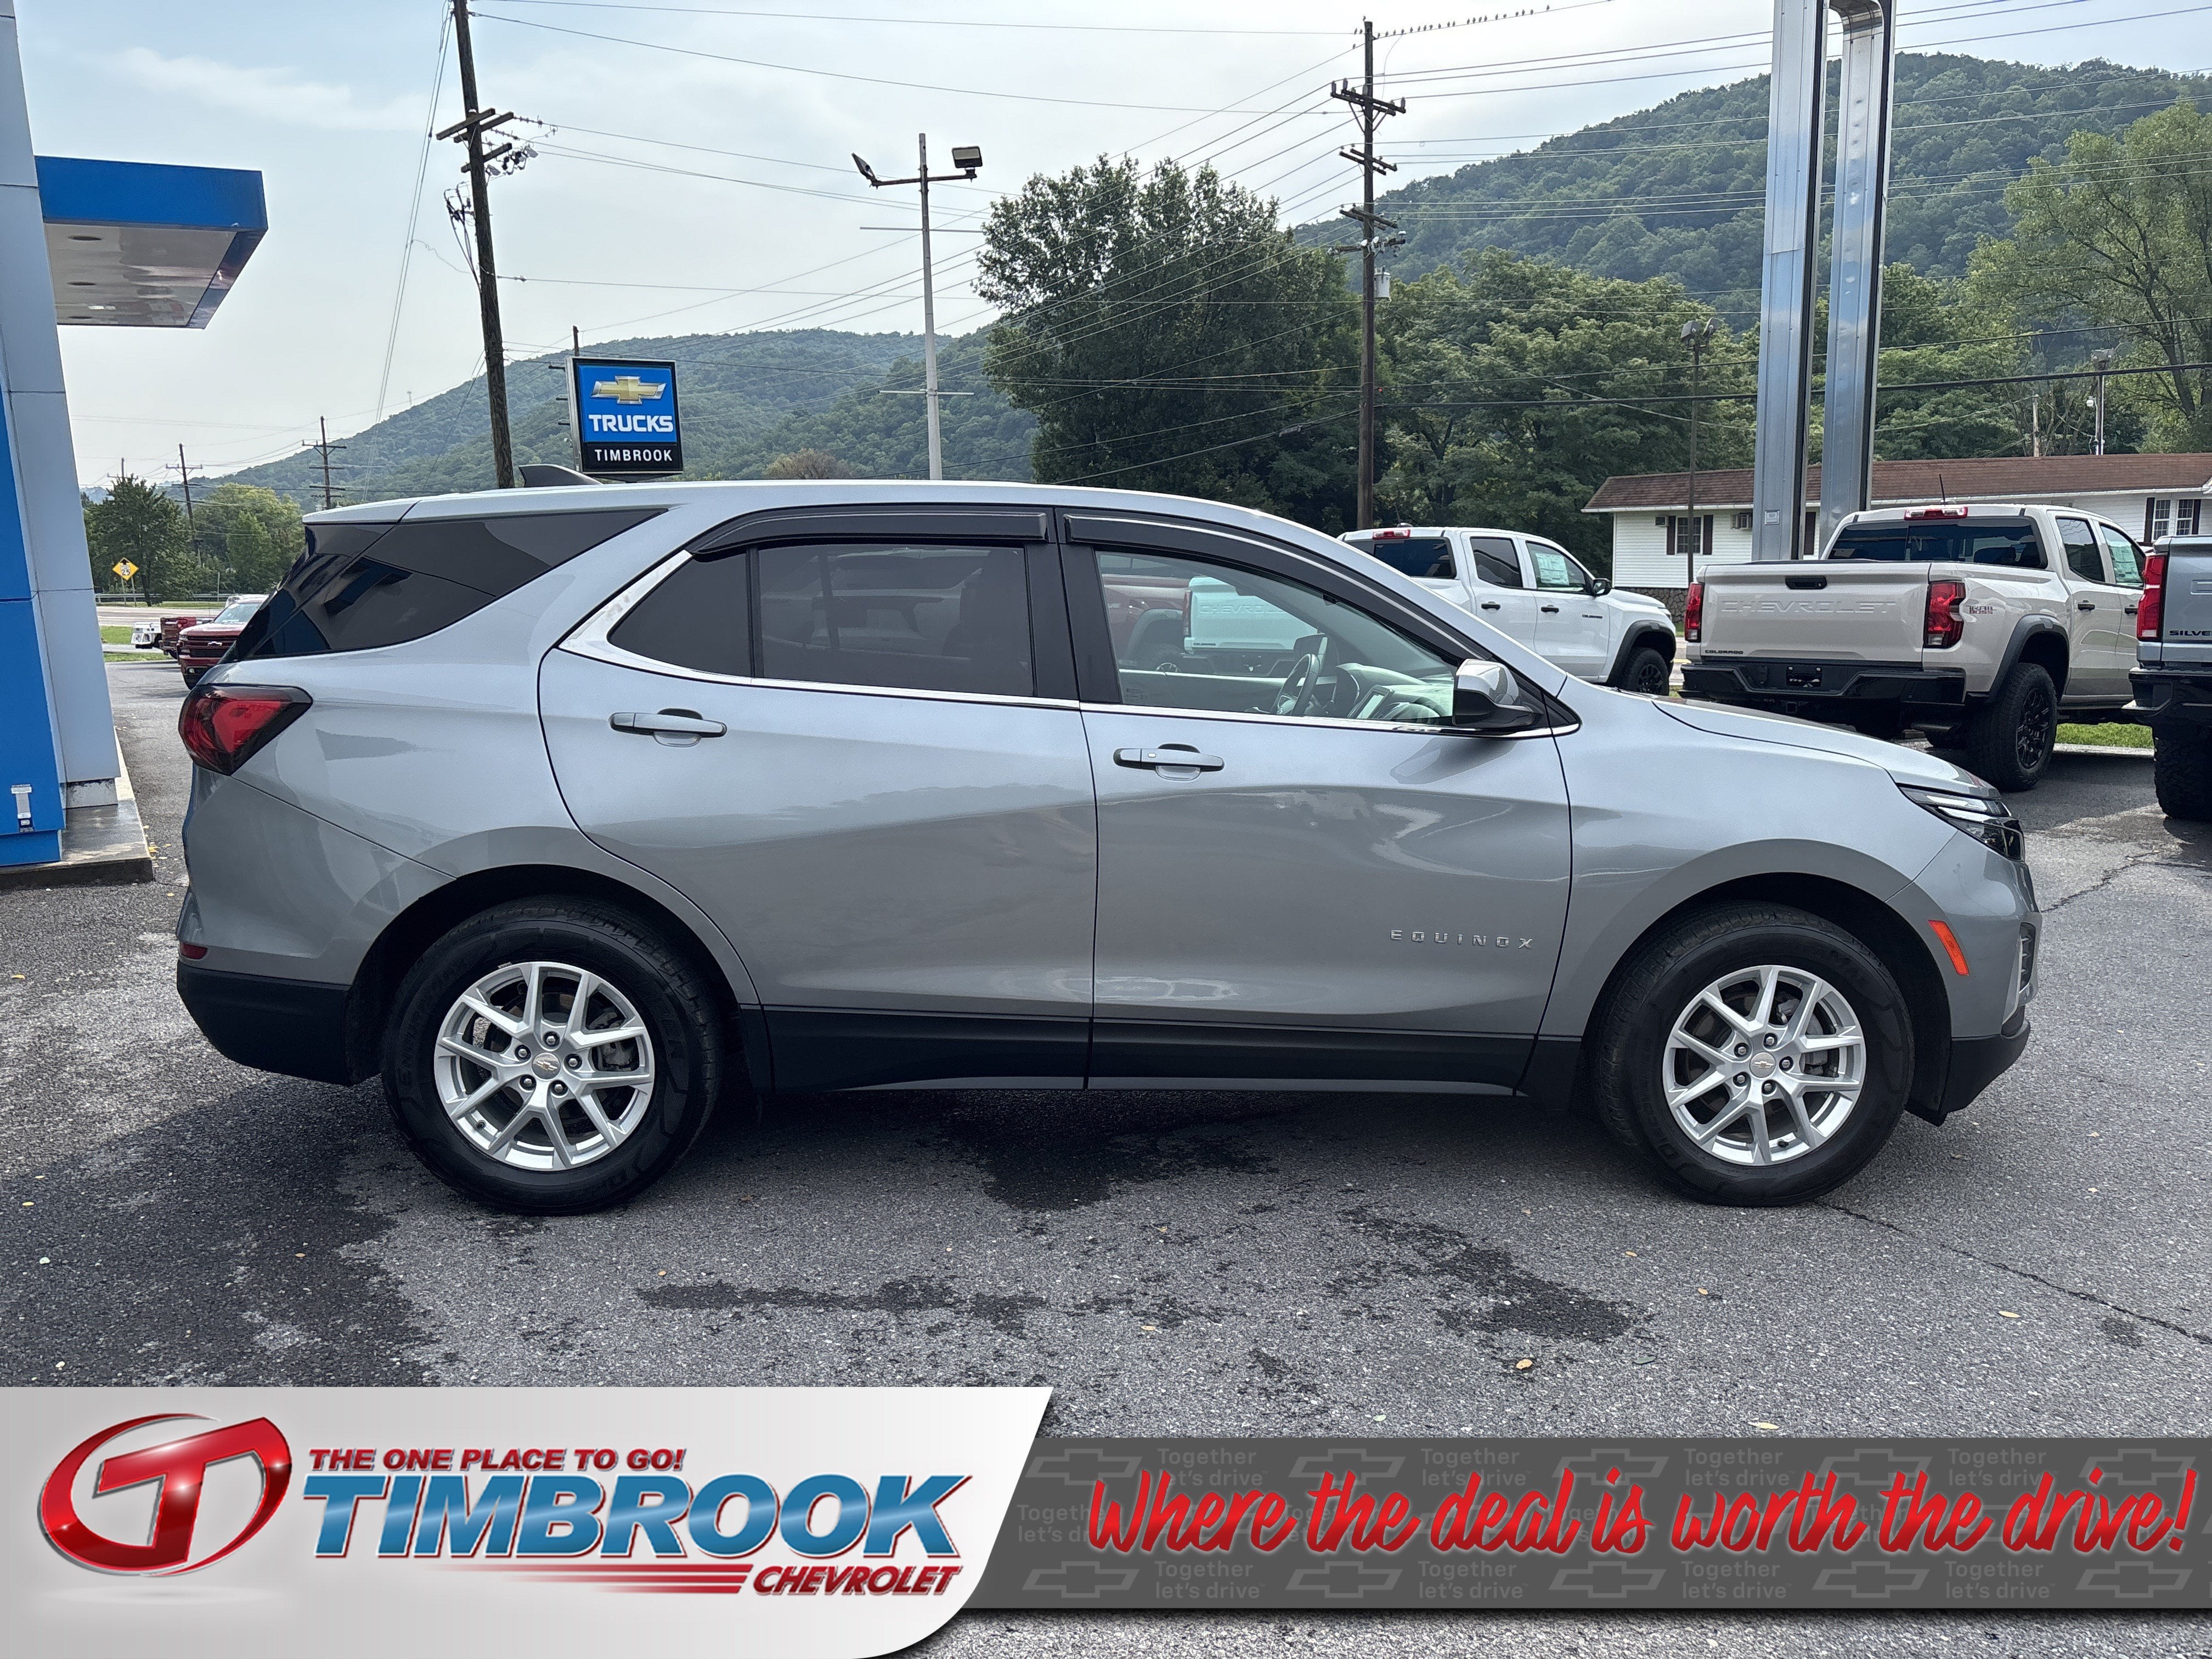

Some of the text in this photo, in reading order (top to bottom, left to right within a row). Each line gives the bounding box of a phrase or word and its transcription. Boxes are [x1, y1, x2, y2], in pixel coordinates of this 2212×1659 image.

[588, 414, 674, 432] TRUCKS
[594, 449, 673, 461] TIMBROOK
[1720, 600, 1897, 613] CHEVROLET
[1390, 930, 1533, 950] EQUINOX
